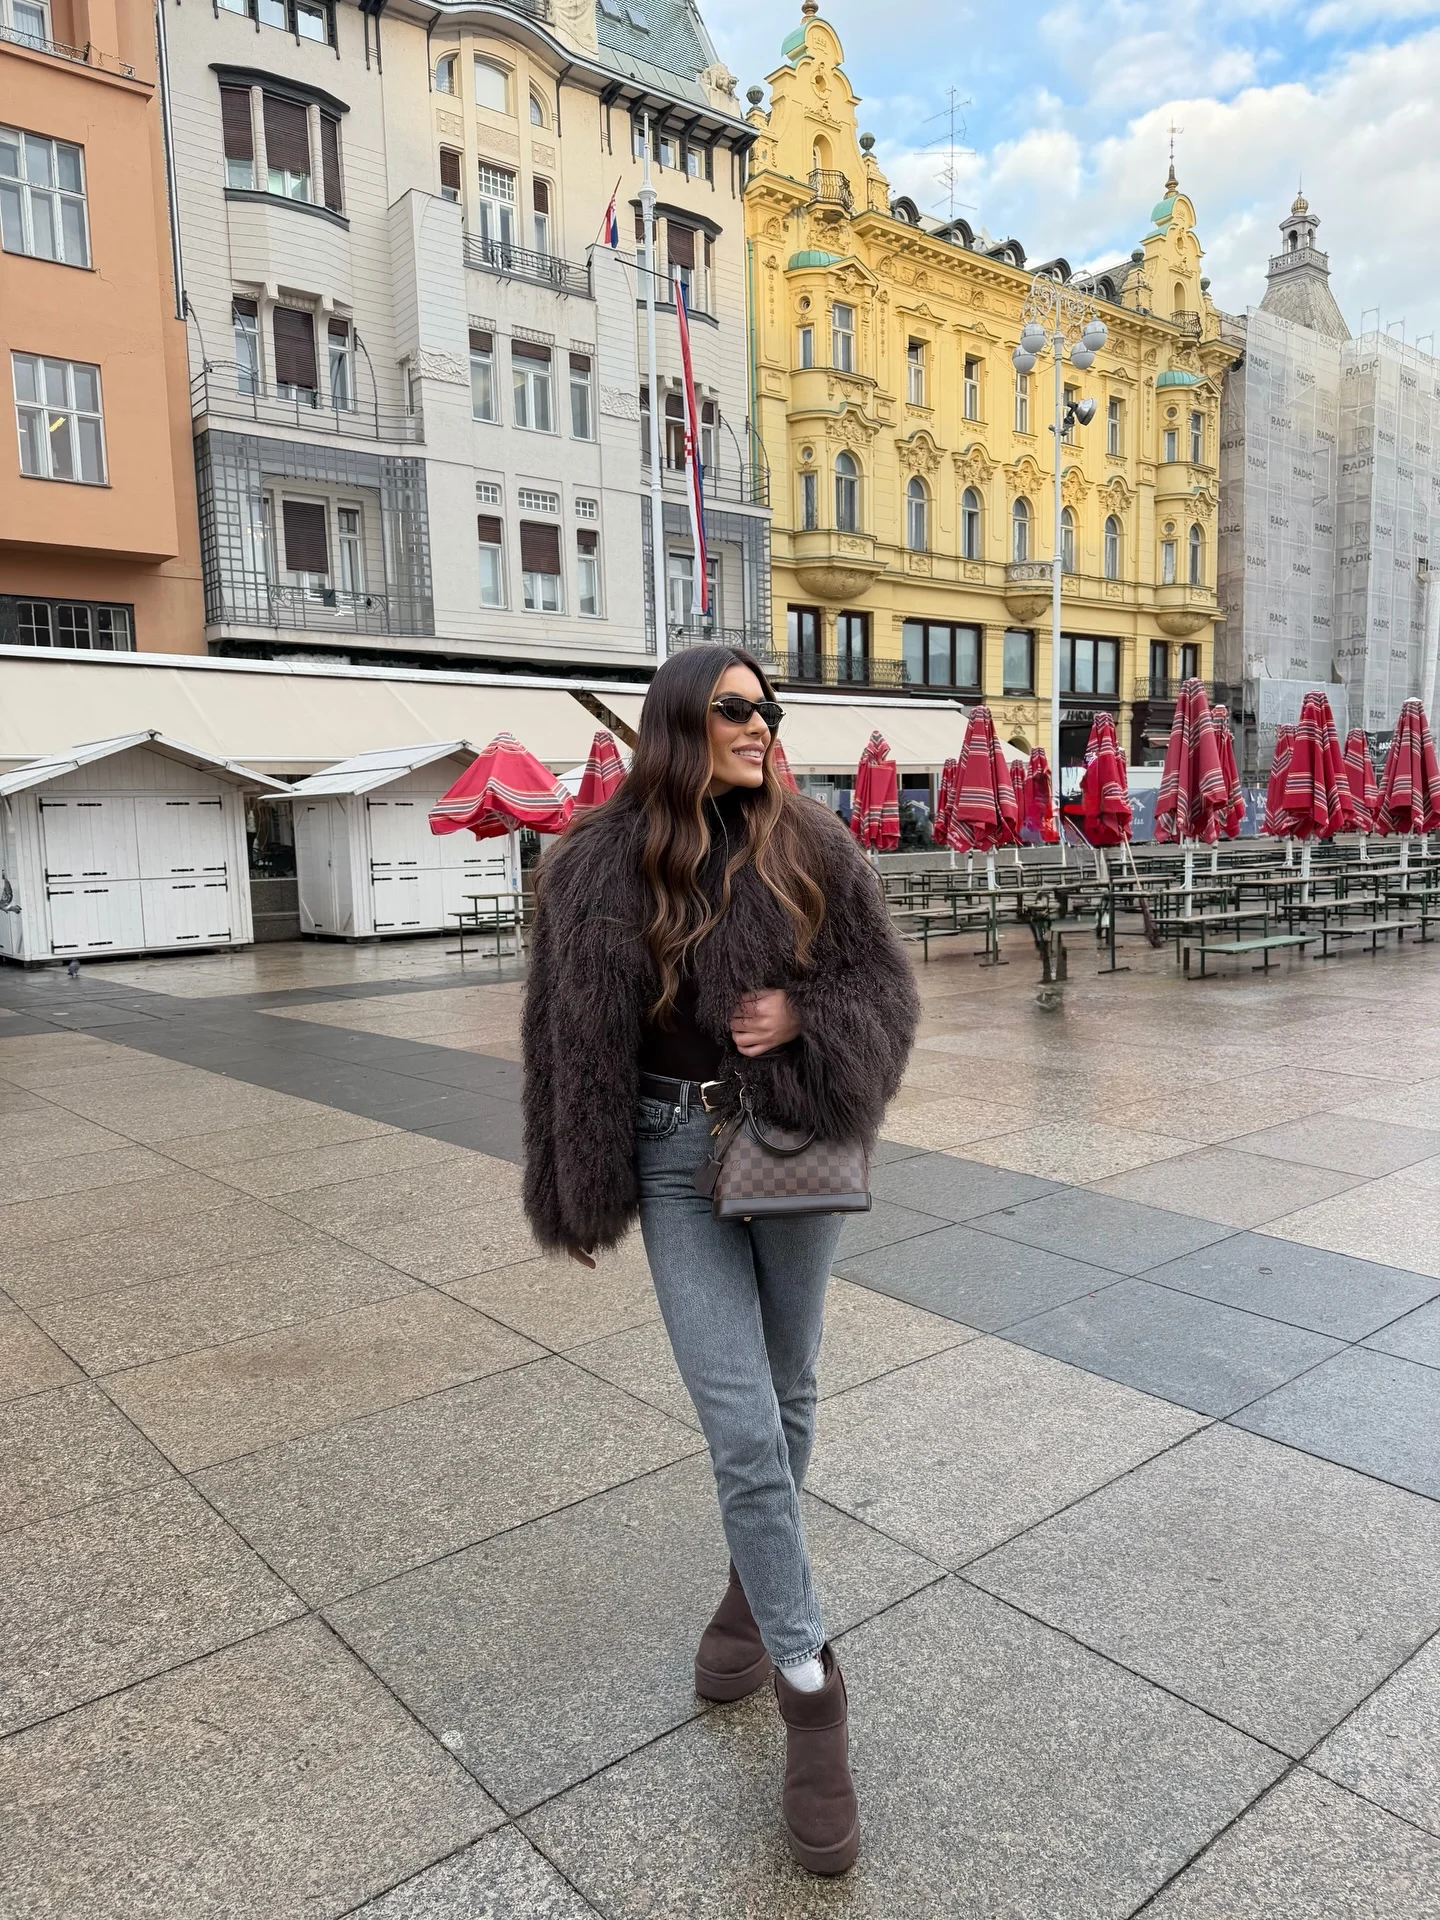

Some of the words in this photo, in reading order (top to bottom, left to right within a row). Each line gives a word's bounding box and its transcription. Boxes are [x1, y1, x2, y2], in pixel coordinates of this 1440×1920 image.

[1250, 354, 1269, 370] RADIĆ
[1345, 356, 1379, 377] RADIĆ
[1297, 370, 1316, 383] RADIĆ
[1271, 416, 1292, 429] RADIĆ
[1220, 436, 1245, 450] ADIĆ
[1317, 430, 1335, 443] RADIĆ
[1247, 455, 1267, 469] RADIĆ
[1293, 467, 1312, 480] RADIĆ
[1270, 516, 1289, 528] RADIĆ
[1247, 555, 1267, 568] RADIĆ
[1293, 563, 1311, 576] RADIĆ
[1270, 613, 1288, 625] RADIĆ
[1290, 657, 1308, 669] RADIĆ
